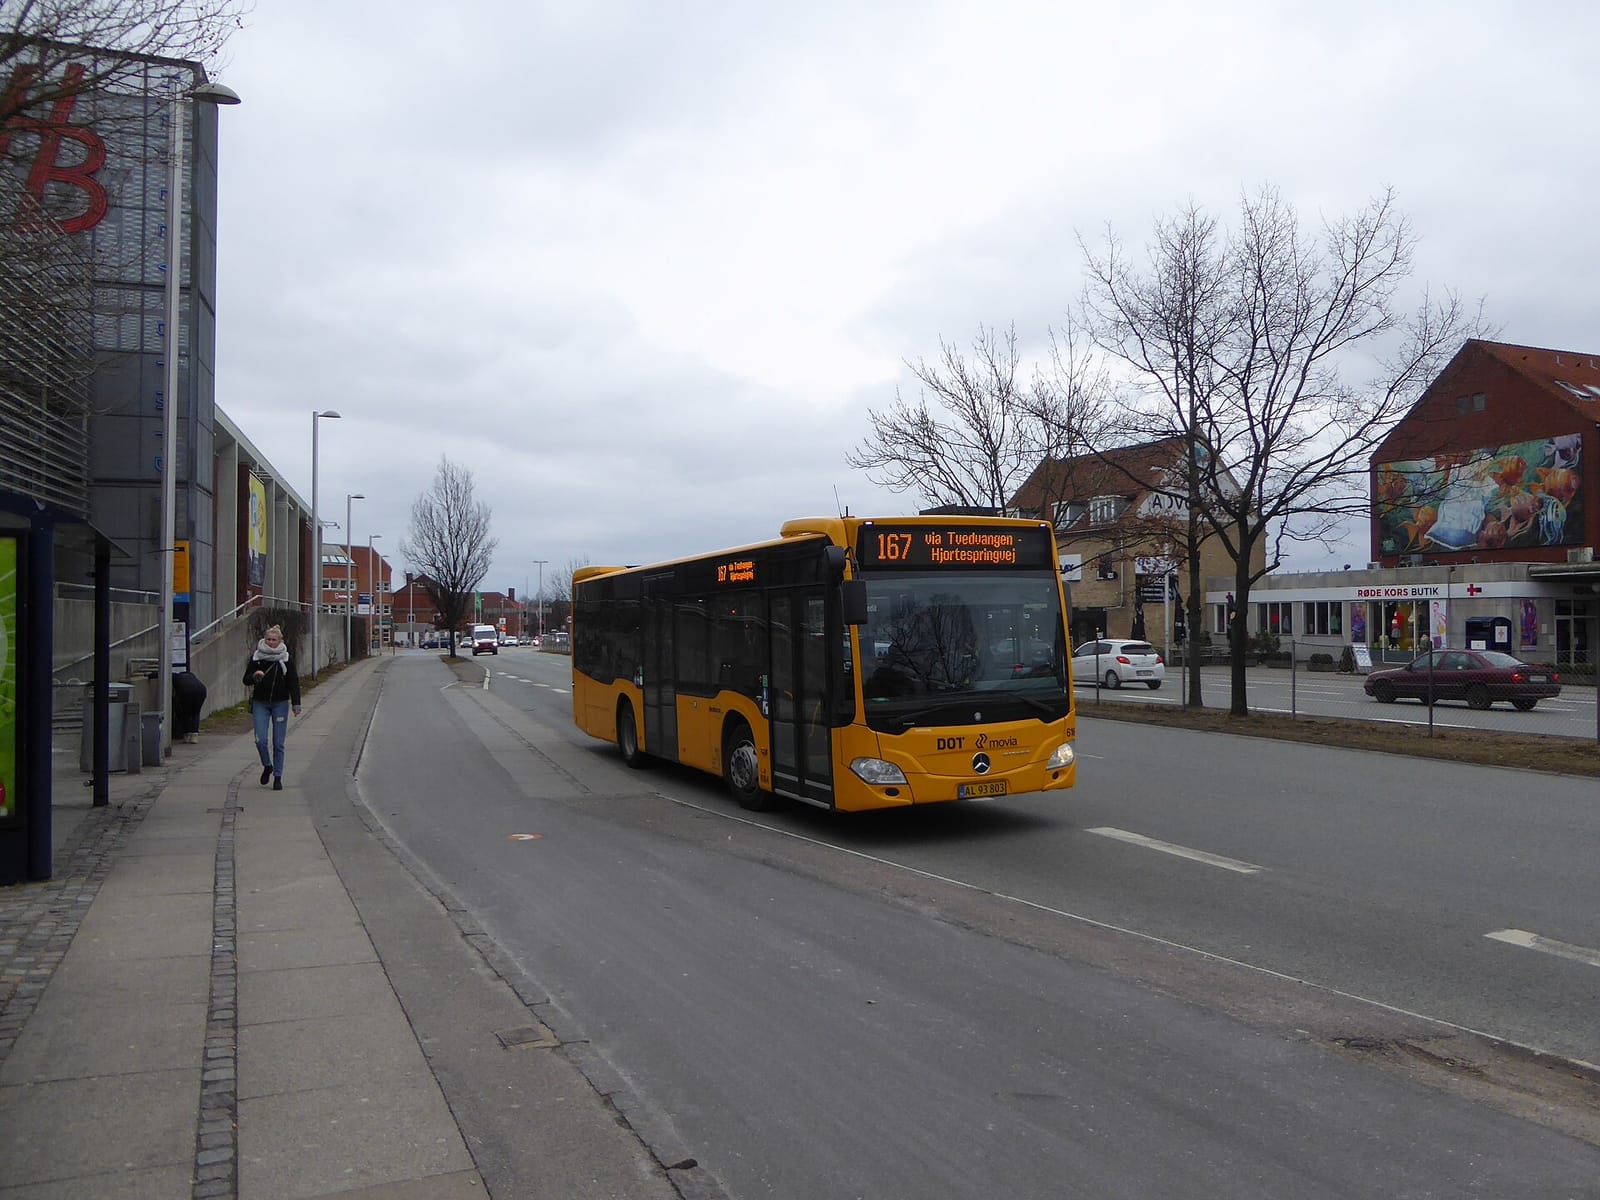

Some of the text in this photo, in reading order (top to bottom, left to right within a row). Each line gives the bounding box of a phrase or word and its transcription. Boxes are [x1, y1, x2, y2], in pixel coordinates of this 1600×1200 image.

[877, 533, 912, 560] 167
[925, 531, 942, 545] via
[947, 531, 1013, 548] Tvedvangen
[931, 547, 1016, 564] Hjortespringvej
[1357, 587, 1439, 598] RØDE KORS BUTIK
[937, 736, 965, 751] DOT
[989, 735, 1018, 750] movia
[964, 782, 1006, 797] AL 93 803
